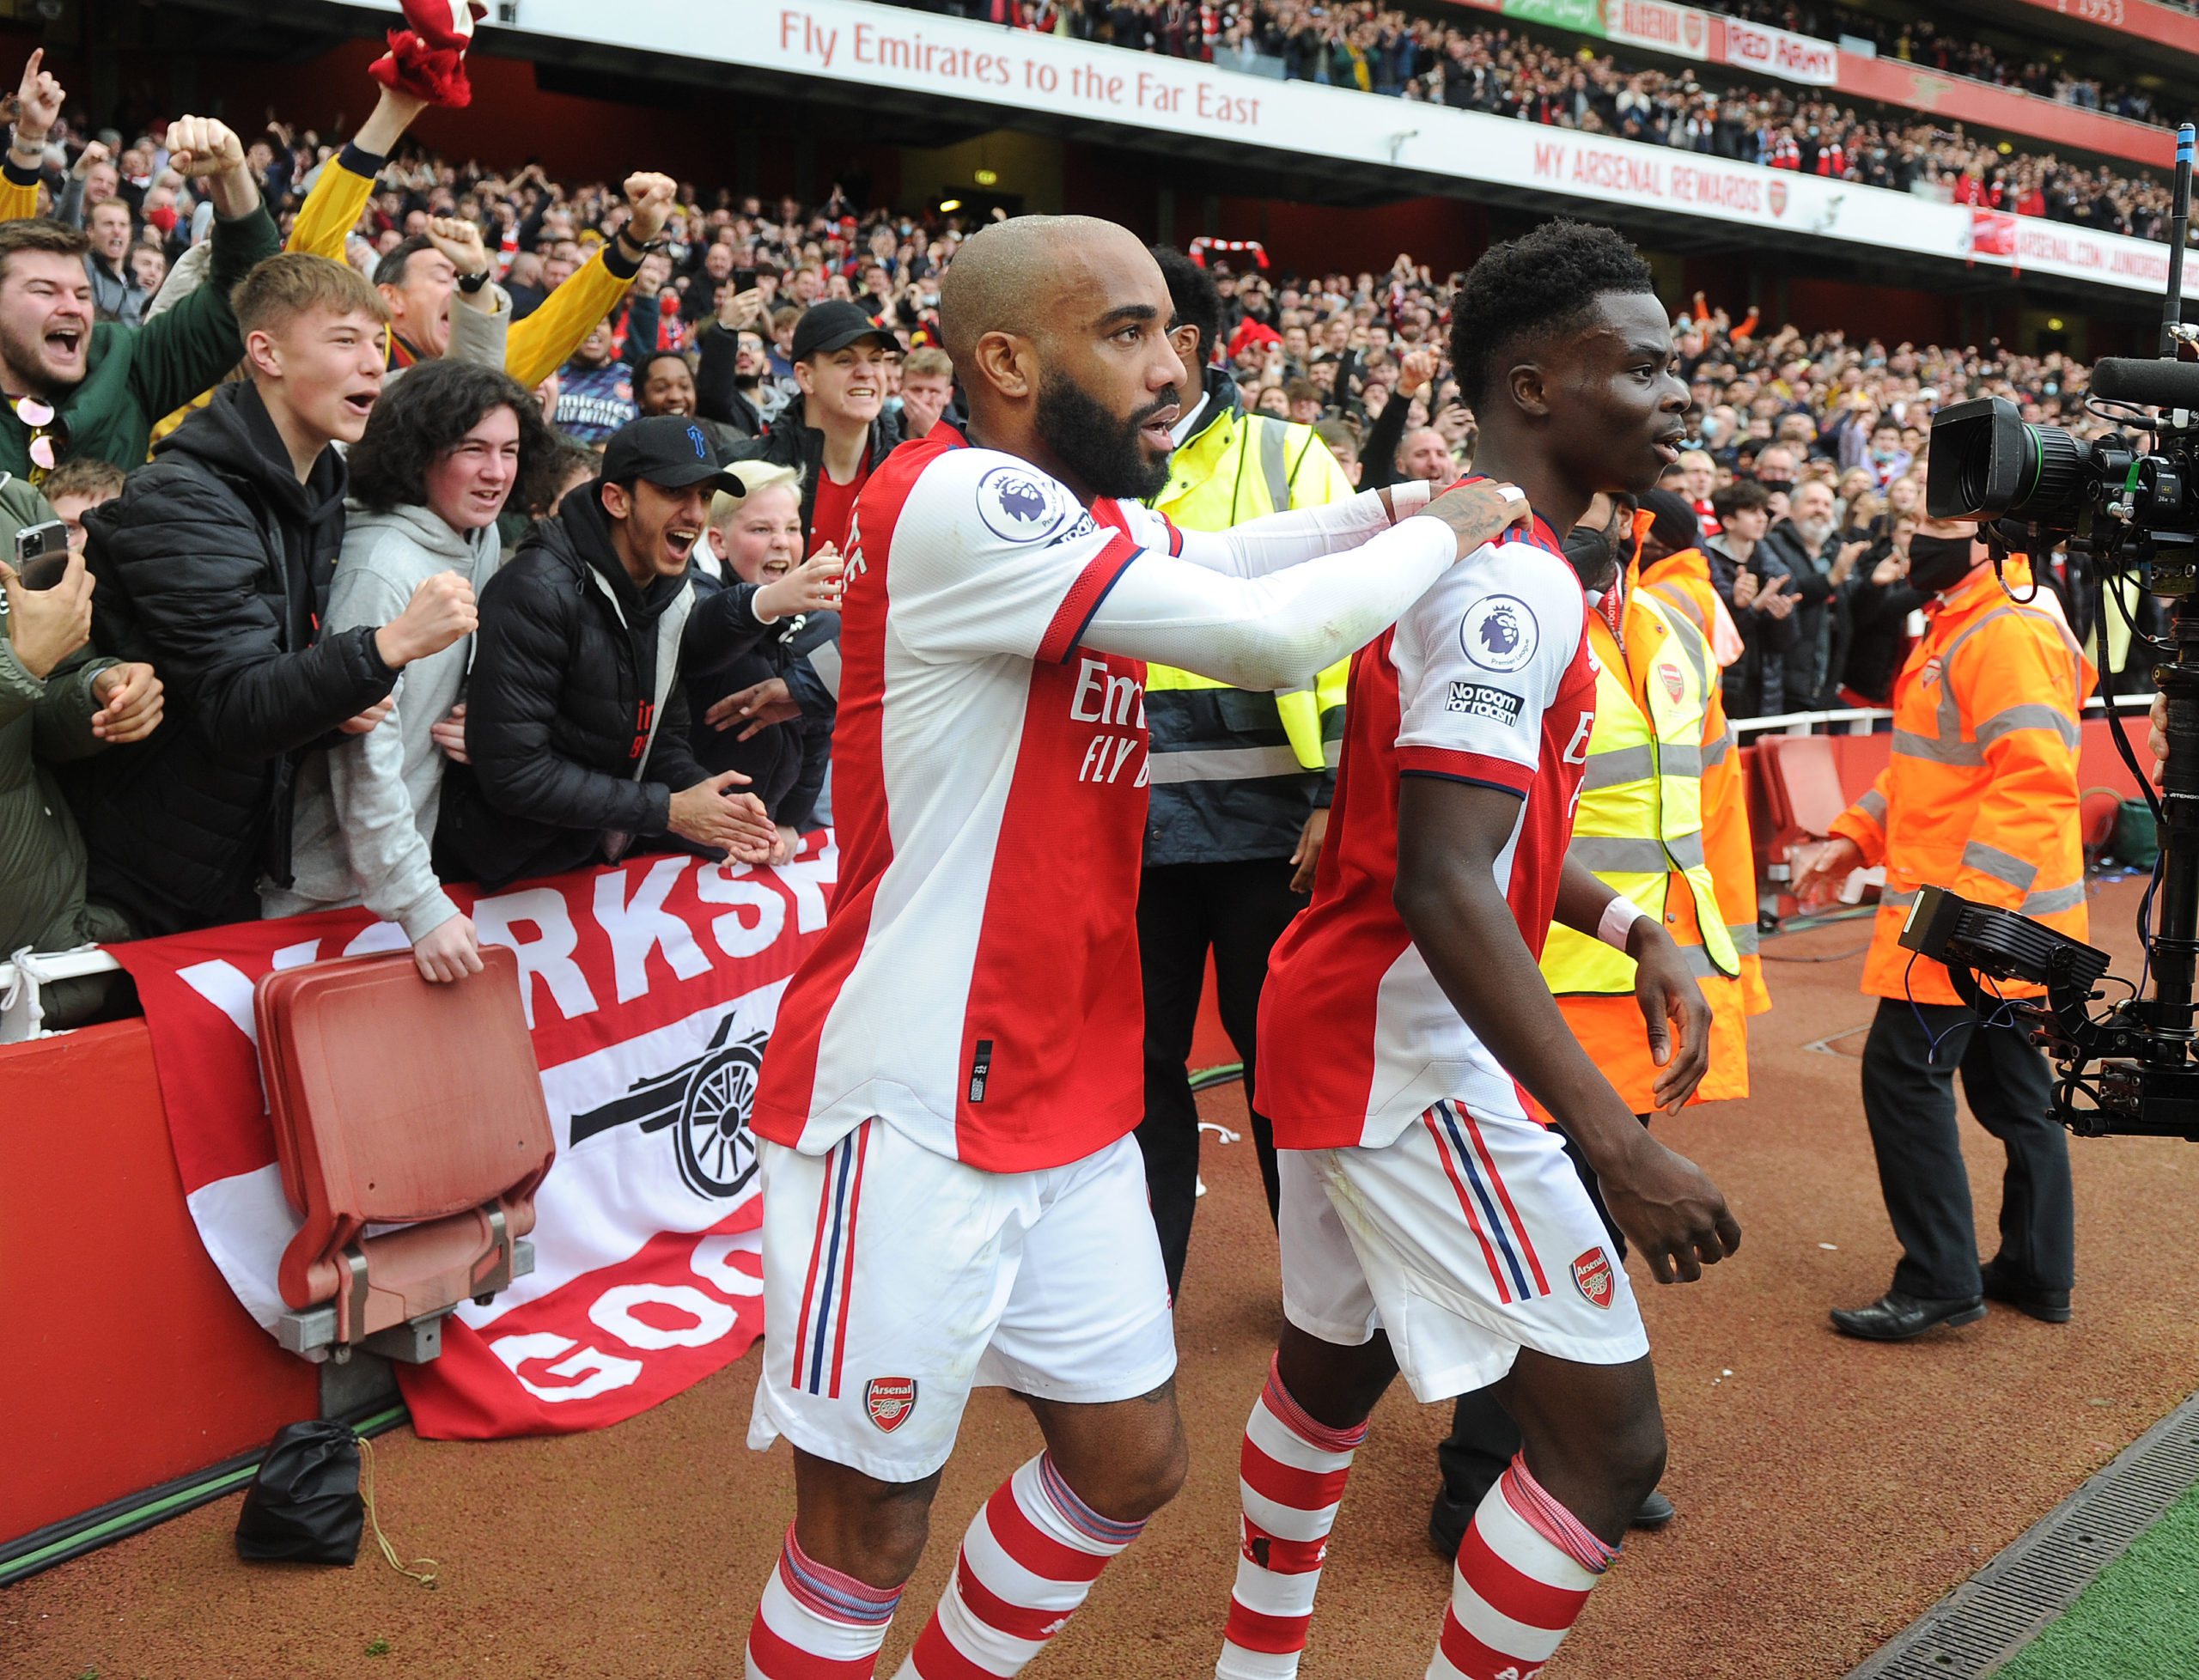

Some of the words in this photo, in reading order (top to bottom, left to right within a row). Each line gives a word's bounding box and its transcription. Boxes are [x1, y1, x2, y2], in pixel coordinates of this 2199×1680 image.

[781, 10, 838, 68] Fly
[854, 22, 1010, 85] Emirates
[1025, 59, 1058, 93] to
[1071, 64, 1124, 105] the
[1136, 72, 1185, 113] Far
[1197, 83, 1260, 125] East
[1727, 23, 1769, 61] RED
[1775, 37, 1832, 76] ARMY
[1534, 141, 1564, 179] MY
[1572, 149, 1663, 197] ARSENAL
[1670, 165, 1761, 213] REWARDS
[1446, 697, 1471, 712] for
[1470, 701, 1518, 727] racism
[1449, 682, 1474, 700] No
[1475, 687, 1517, 711] room
[1078, 735, 1139, 783] FLY
[1577, 1254, 1605, 1277] Arsenal
[871, 1385, 911, 1395] Arsenal
